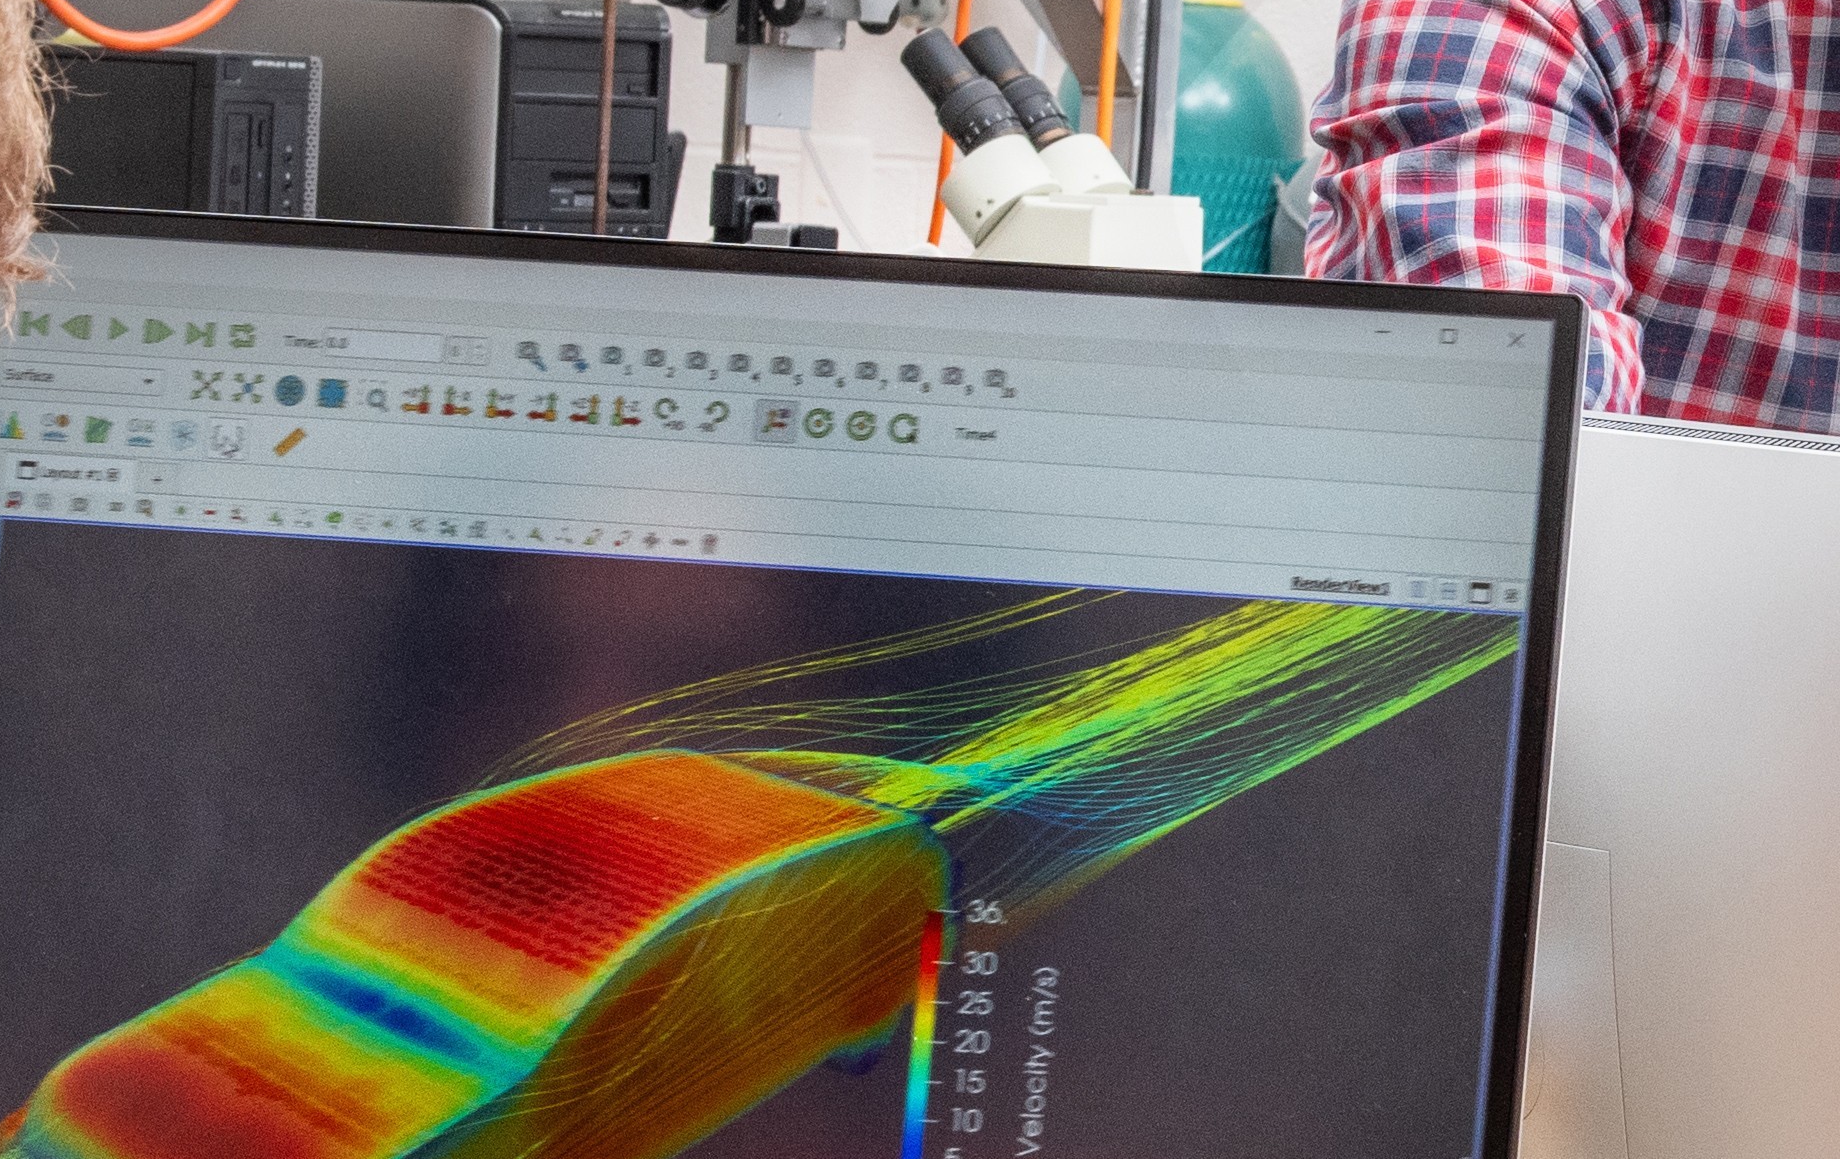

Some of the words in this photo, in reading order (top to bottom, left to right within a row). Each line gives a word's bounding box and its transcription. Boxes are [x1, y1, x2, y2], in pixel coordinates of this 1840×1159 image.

[961, 951, 998, 976] 30
[957, 991, 994, 1015] 25
[1028, 967, 1061, 1036] (m/s)
[954, 1029, 991, 1054] 20
[955, 1068, 987, 1094] 15
[1015, 1044, 1056, 1157] Velocity
[951, 1107, 984, 1133] 10
